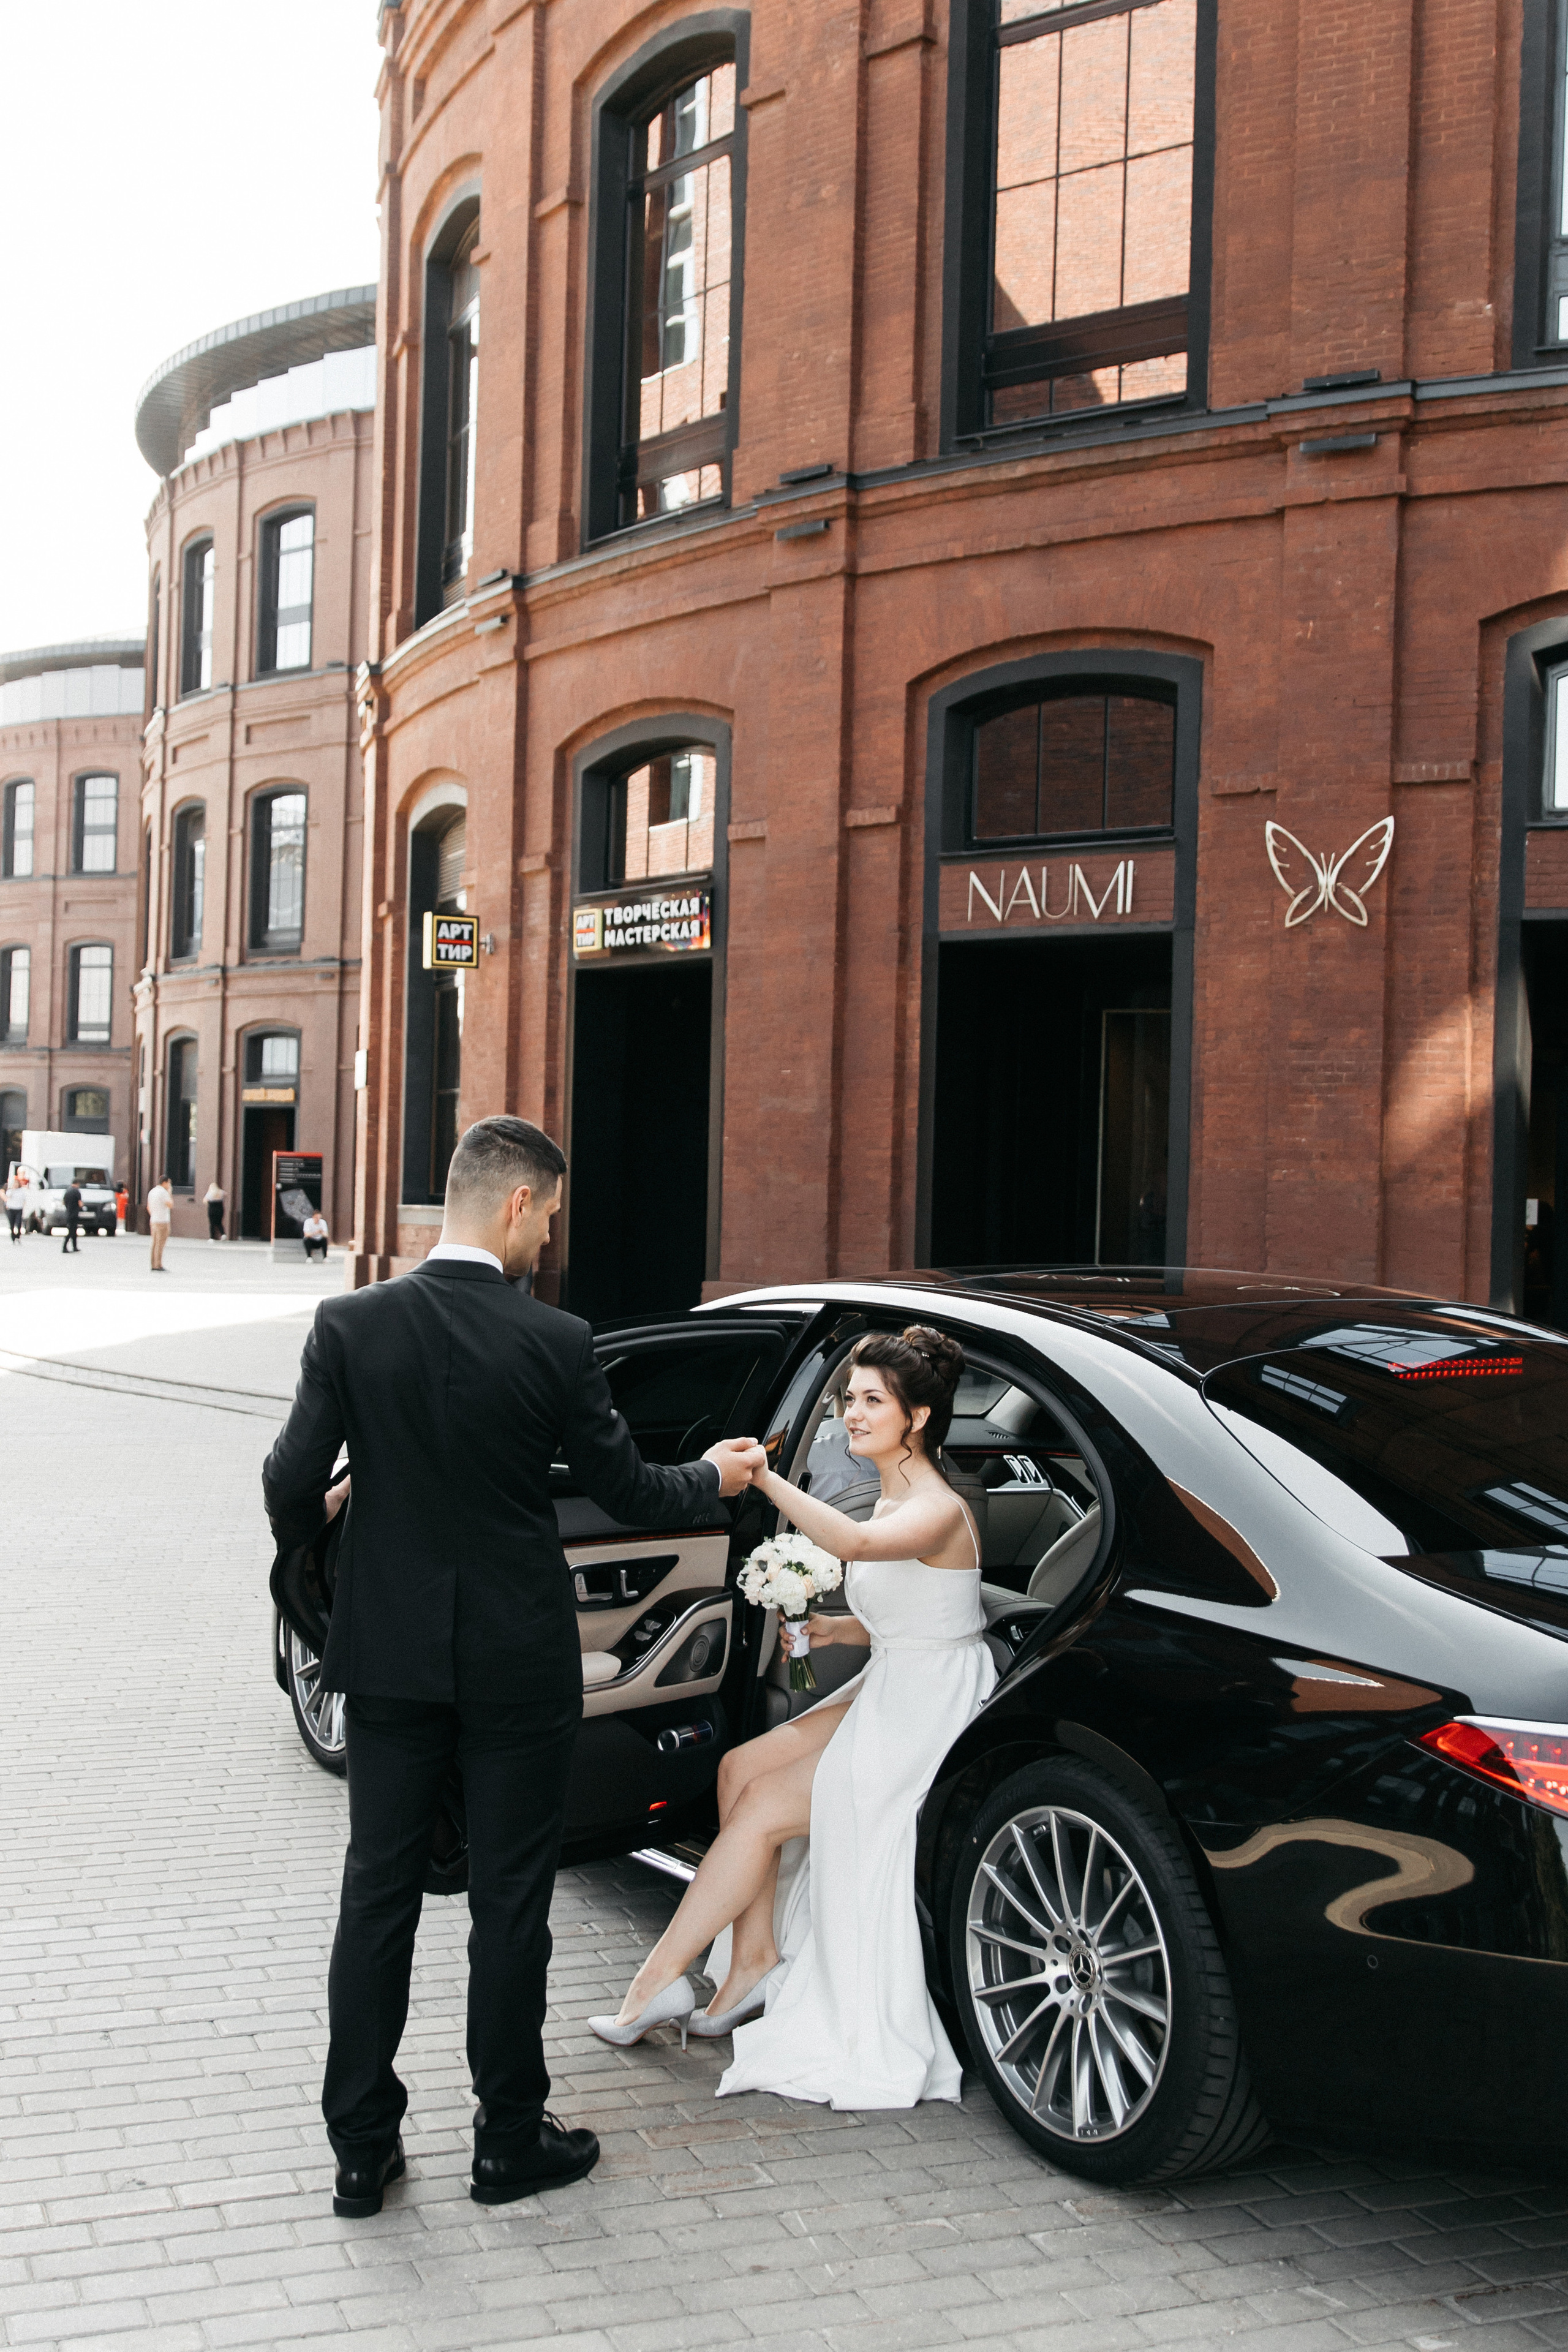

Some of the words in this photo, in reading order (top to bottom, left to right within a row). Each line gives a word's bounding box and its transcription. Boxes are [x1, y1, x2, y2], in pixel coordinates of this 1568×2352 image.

[968, 859, 1134, 922] NAUMI
[603, 897, 700, 926] ТВОРЧЕСКАЯ
[437, 922, 473, 940] АРТ
[576, 914, 595, 930] АРТ
[576, 931, 595, 947] ТИР
[603, 919, 700, 948] МАСТЕРСКАЯ
[437, 943, 473, 961] ТИР
